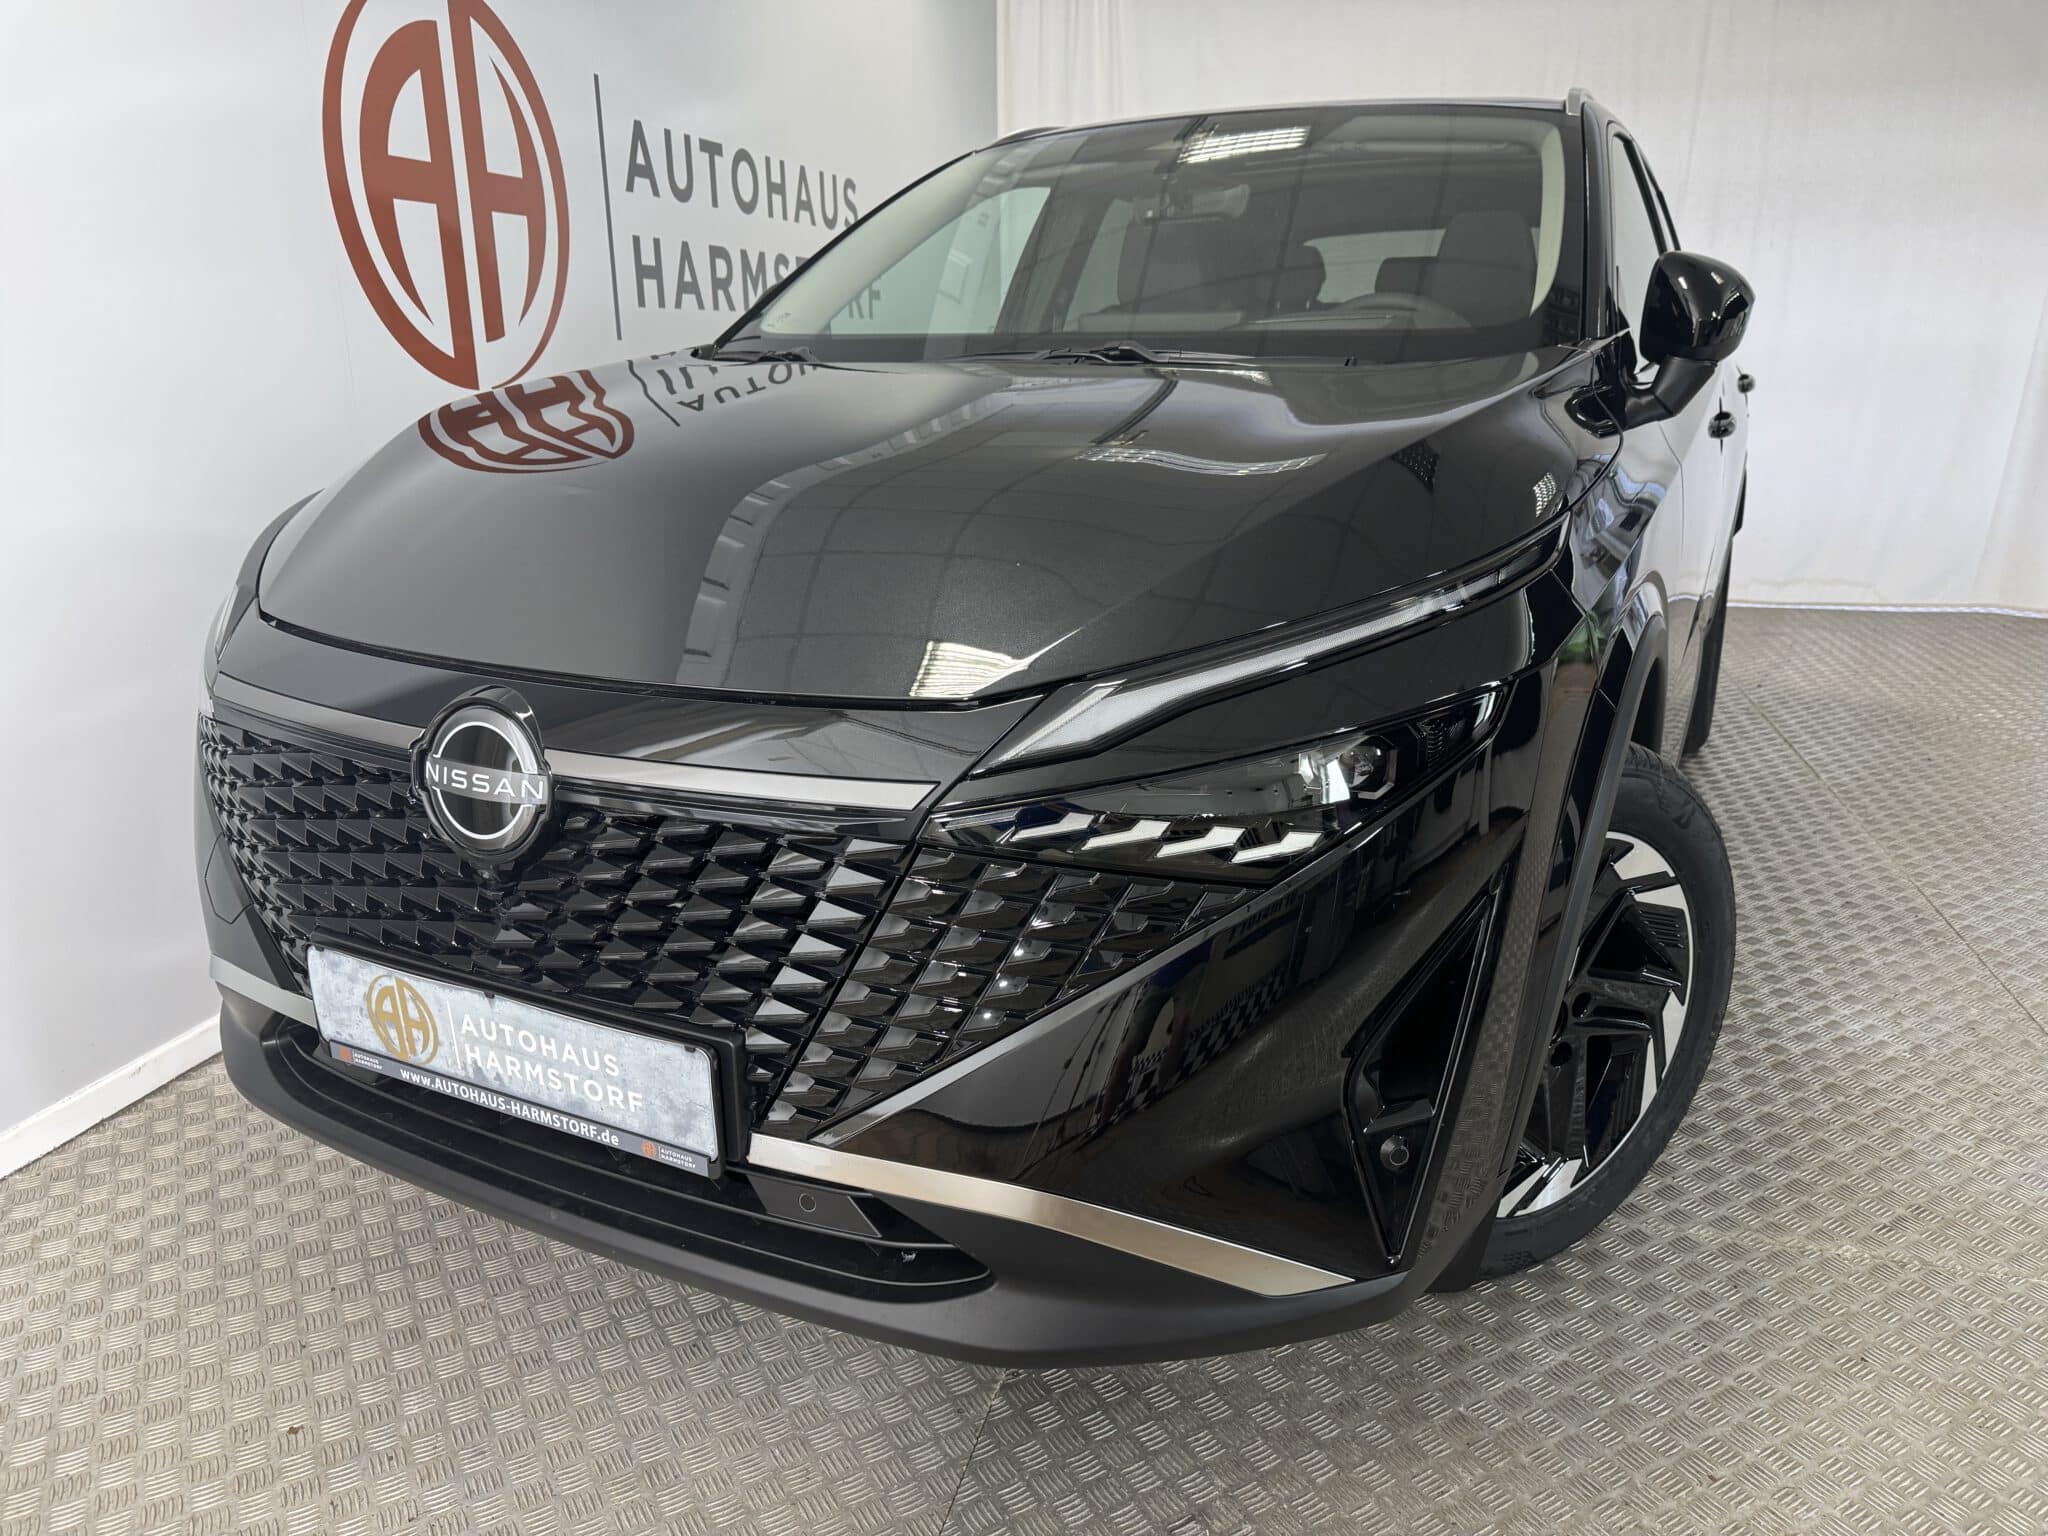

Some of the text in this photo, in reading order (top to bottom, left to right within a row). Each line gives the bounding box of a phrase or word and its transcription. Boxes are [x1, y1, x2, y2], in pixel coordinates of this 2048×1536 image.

[625, 119, 860, 231] AUTOHAUS
[425, 760, 544, 800] NISSAN
[460, 1013, 620, 1077] AUTOHAUS
[465, 1043, 644, 1113] HARMSTORF
[400, 1068, 619, 1146] www.AUTOHAUS-HARMSTORF.de
